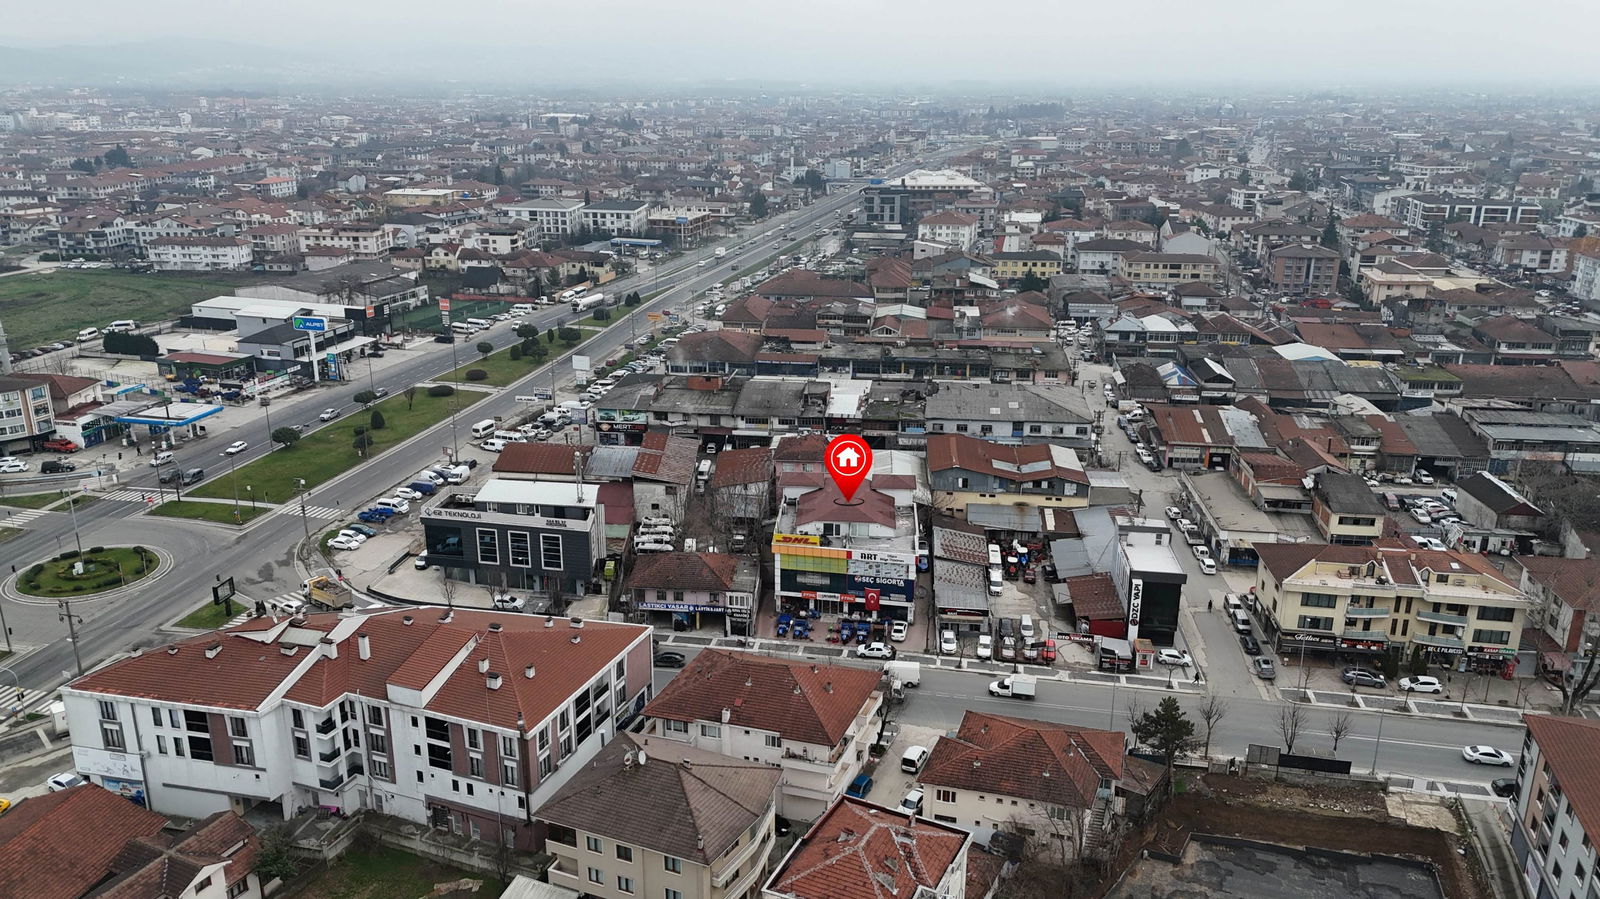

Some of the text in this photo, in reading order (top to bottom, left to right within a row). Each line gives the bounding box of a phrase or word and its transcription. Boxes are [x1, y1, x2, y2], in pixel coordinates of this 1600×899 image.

[779, 535, 813, 545] DHL
[1131, 583, 1141, 619] DZC YAPI
